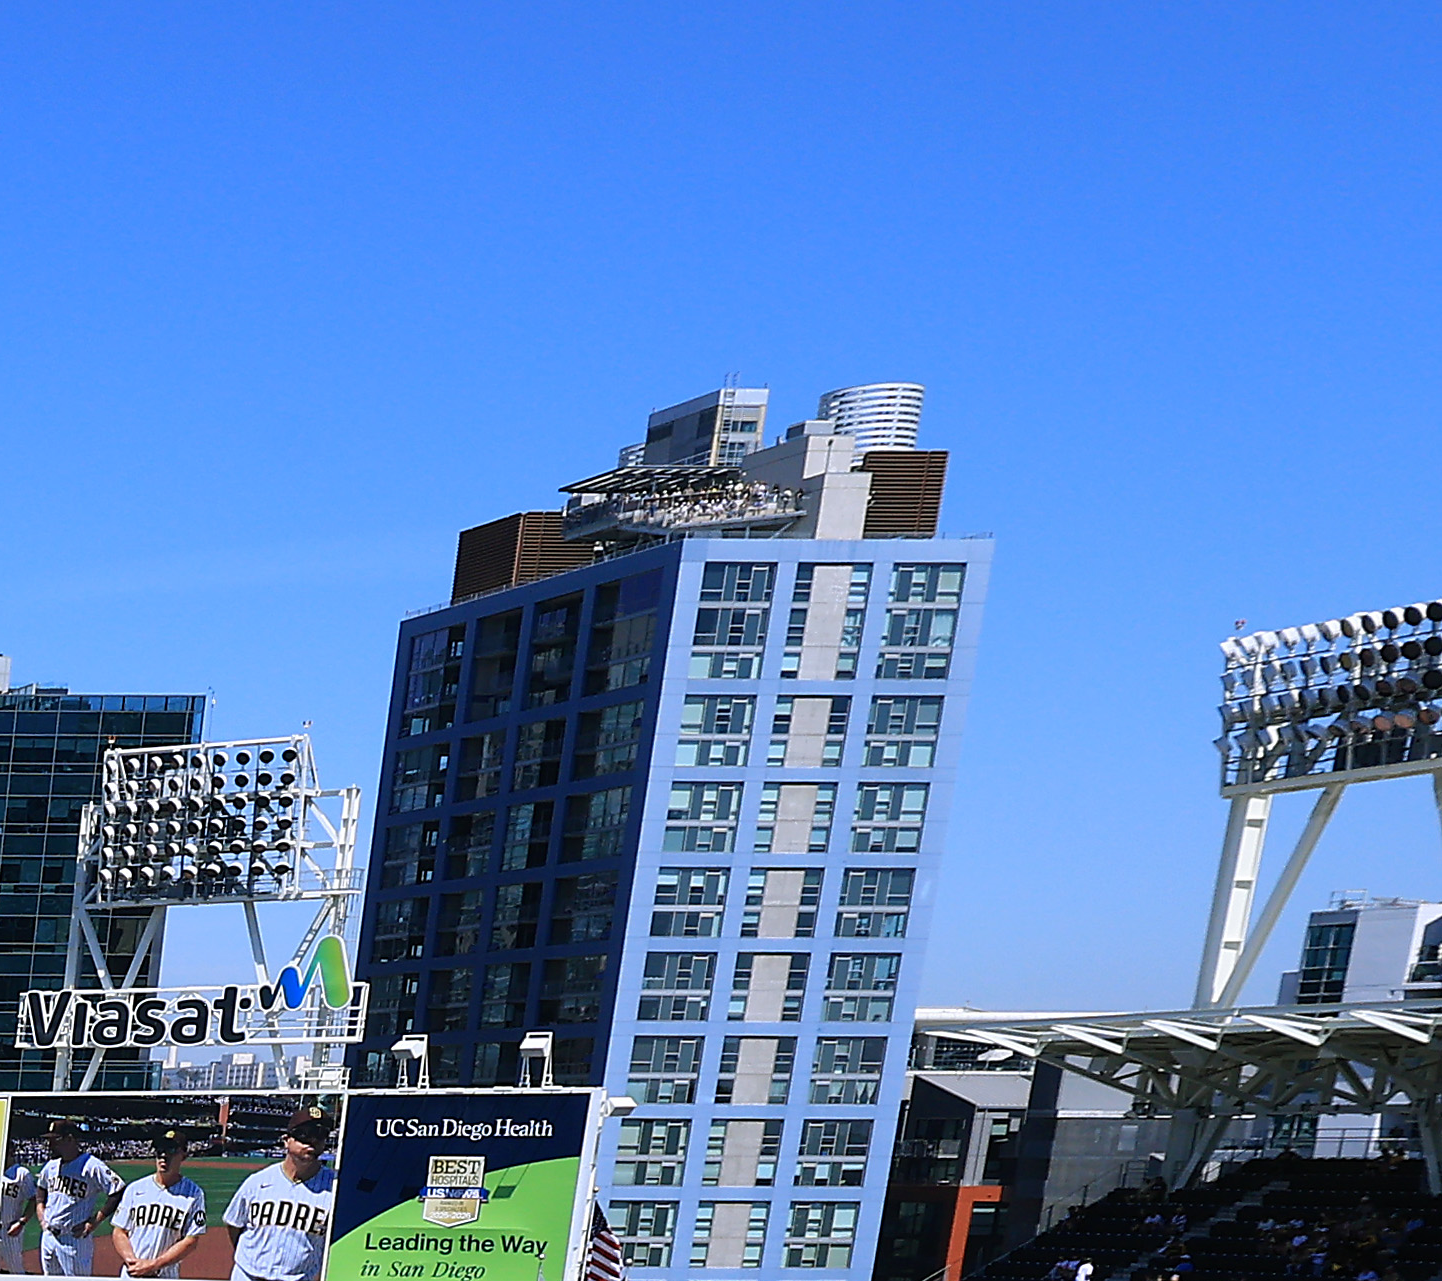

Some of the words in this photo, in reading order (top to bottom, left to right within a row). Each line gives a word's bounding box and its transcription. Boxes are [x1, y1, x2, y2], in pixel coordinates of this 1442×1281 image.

[28, 986, 247, 1048] Viasat
[376, 1118, 405, 1137] UC
[405, 1118, 439, 1137] San
[441, 1118, 493, 1141] Diego
[494, 1118, 554, 1138] Health
[432, 1160, 480, 1174] BEST
[430, 1175, 479, 1185] HOSPITALS
[365, 1233, 453, 1255] Leading
[458, 1233, 494, 1252] the
[501, 1235, 548, 1259] Way
[361, 1261, 380, 1276] in
[387, 1261, 424, 1277] San
[431, 1261, 486, 1281] Diego
